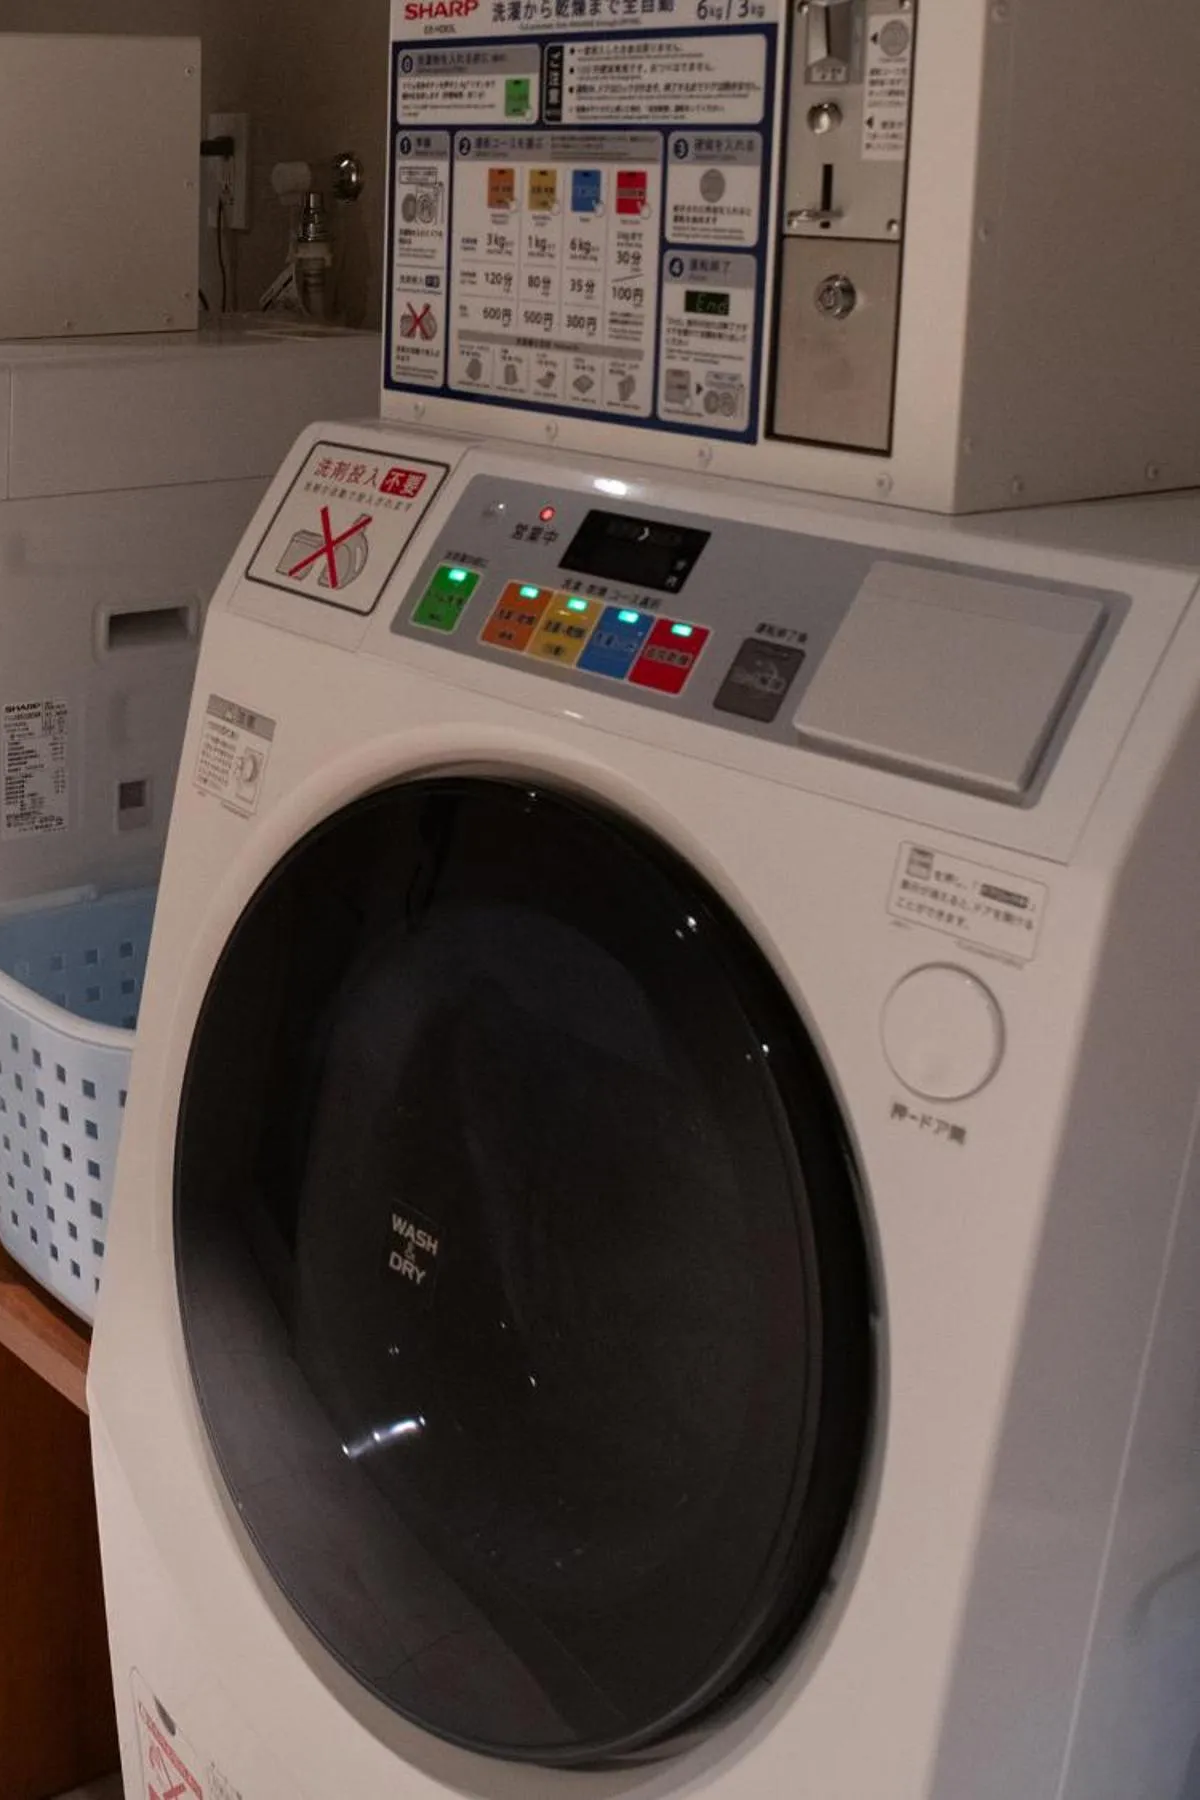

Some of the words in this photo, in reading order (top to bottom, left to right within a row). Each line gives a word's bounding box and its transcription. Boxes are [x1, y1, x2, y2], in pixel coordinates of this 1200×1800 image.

[404, 0, 480, 20] SHARP
[612, 286, 644, 304] 100円
[314, 457, 380, 488] 洗剤投入
[382, 469, 425, 497] 不要
[391, 1213, 439, 1257] WASH
[388, 1251, 427, 1285] DRY
